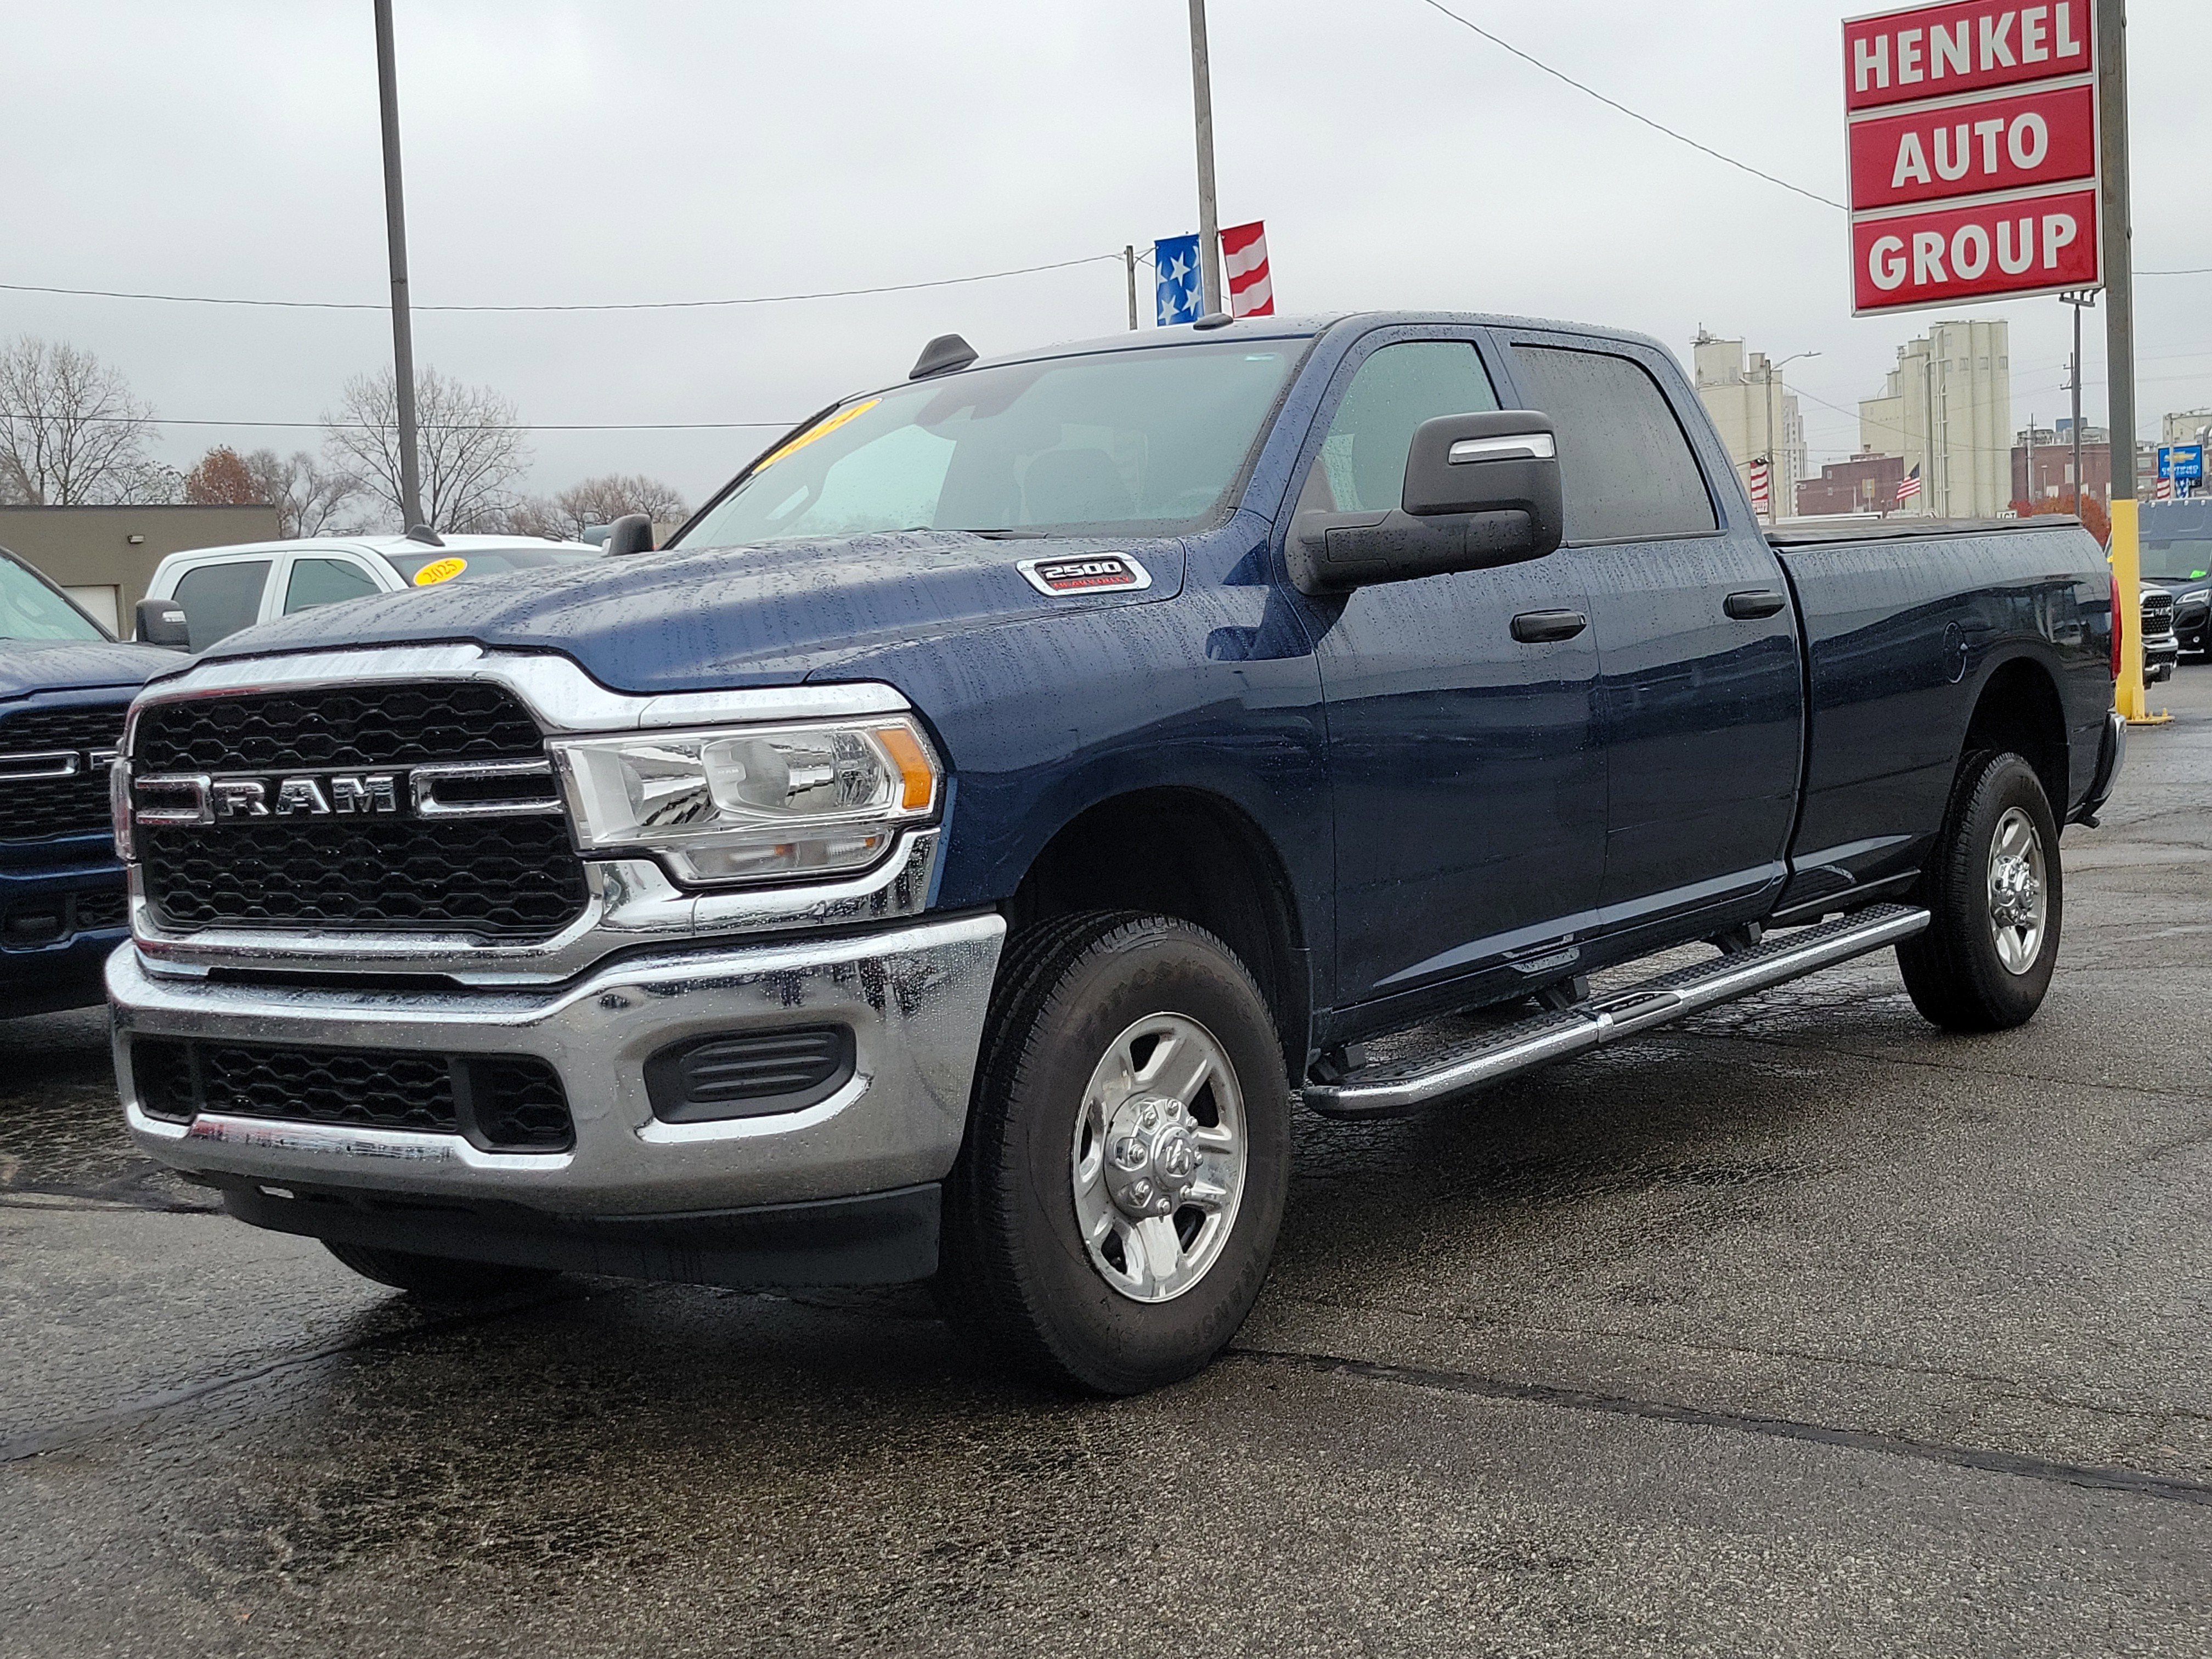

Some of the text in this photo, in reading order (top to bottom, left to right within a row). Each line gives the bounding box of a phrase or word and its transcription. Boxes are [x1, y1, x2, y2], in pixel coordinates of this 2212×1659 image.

[1854, 2, 2081, 93] HENKEL
[1891, 112, 2049, 189] AUTO
[1869, 213, 2078, 291] GROUP
[422, 560, 458, 583] 2025
[1043, 561, 1122, 579] 2500
[1097, 576, 1130, 585] DUTY
[212, 776, 397, 817] RAM
